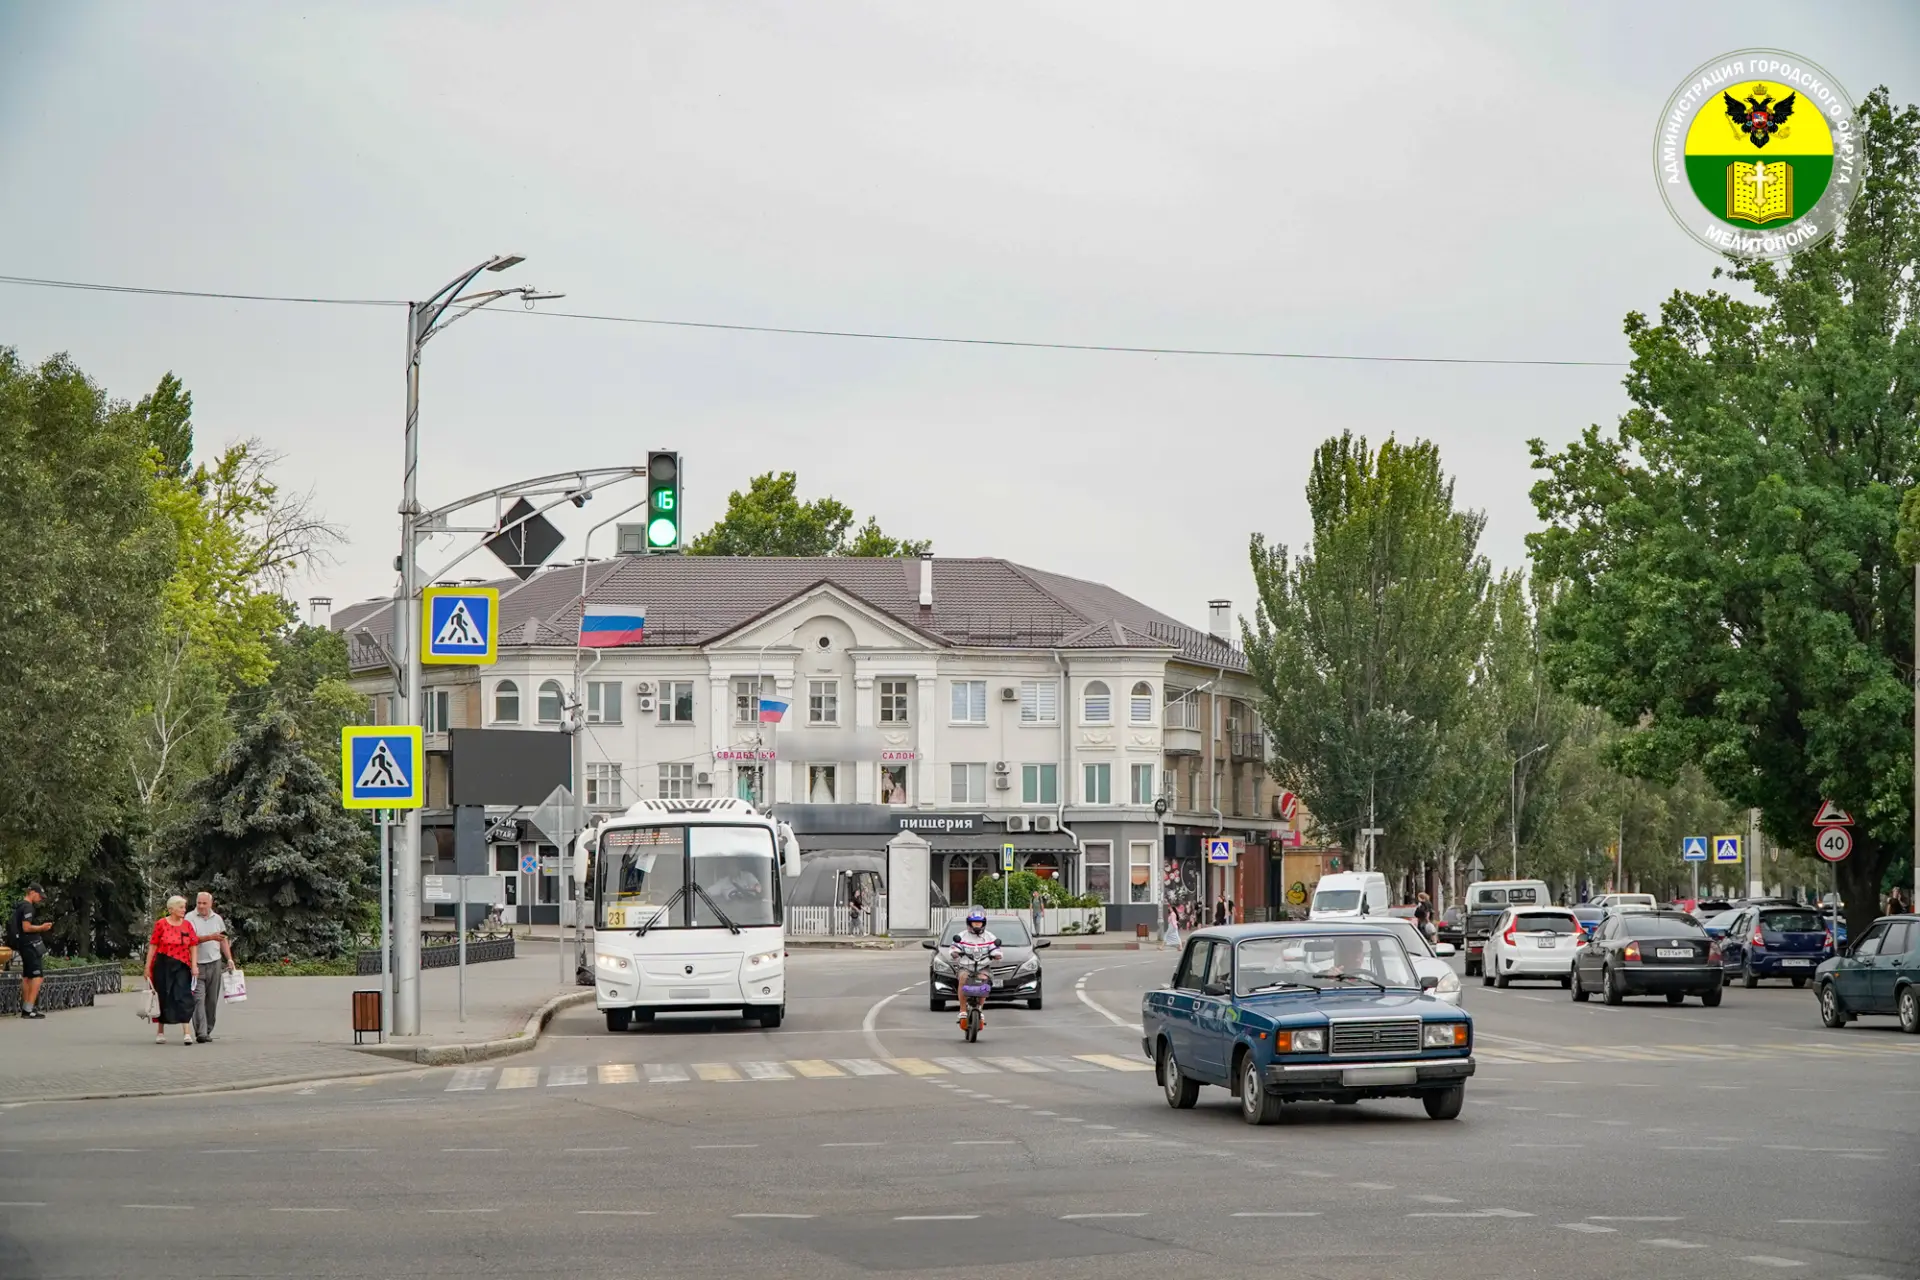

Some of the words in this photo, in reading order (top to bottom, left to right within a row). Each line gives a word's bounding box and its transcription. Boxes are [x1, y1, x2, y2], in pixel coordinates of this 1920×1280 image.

[658, 490, 674, 510] 16
[882, 752, 915, 760] САЛОН
[900, 817, 973, 832] пиццерия
[1824, 836, 1845, 851] 40
[608, 911, 626, 926] 231
